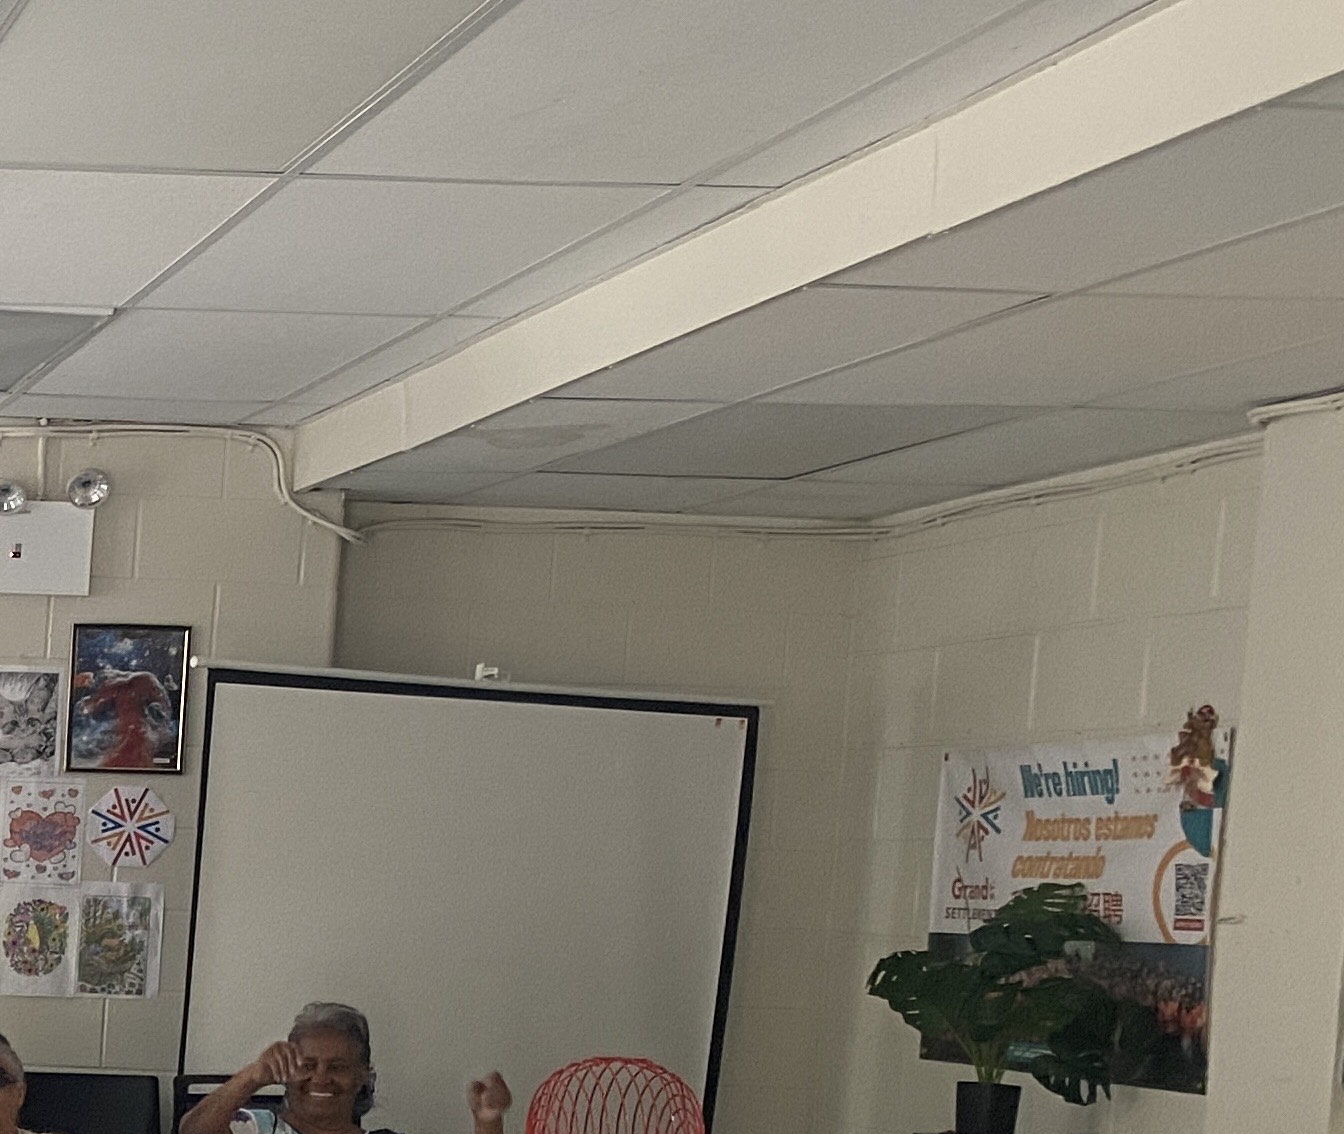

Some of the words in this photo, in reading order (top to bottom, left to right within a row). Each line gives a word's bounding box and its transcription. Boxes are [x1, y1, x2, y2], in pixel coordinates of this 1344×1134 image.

[1019, 763, 1062, 798] We're
[1062, 758, 1120, 805] hiring!
[1022, 810, 1091, 842] Nosotros
[1095, 811, 1158, 840] estamos
[1011, 846, 1106, 879] contratando
[951, 876, 989, 900] Grand
